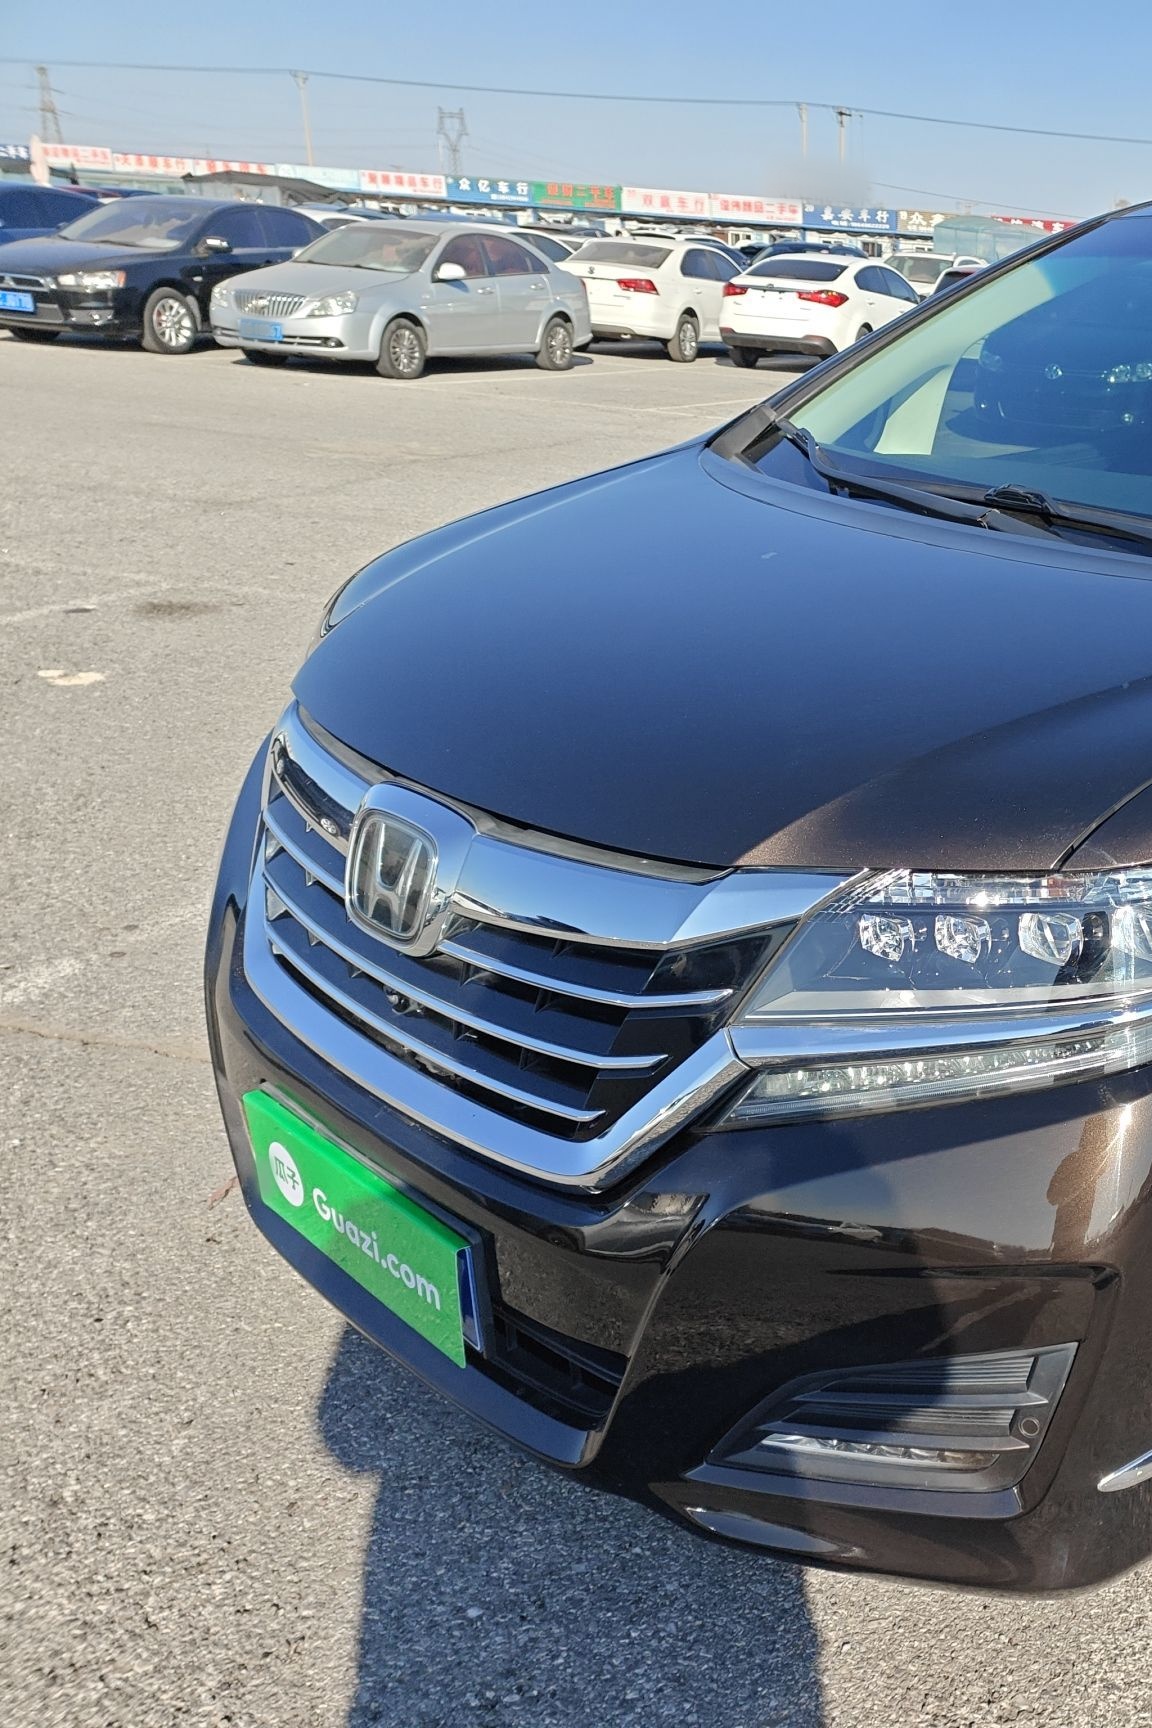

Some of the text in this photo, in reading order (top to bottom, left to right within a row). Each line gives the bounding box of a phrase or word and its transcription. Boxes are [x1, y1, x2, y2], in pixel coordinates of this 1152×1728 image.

[458, 177, 529, 195] 众亿车行
[273, 1155, 300, 1192] 瓜子
[312, 1187, 441, 1311] Guazi.com
